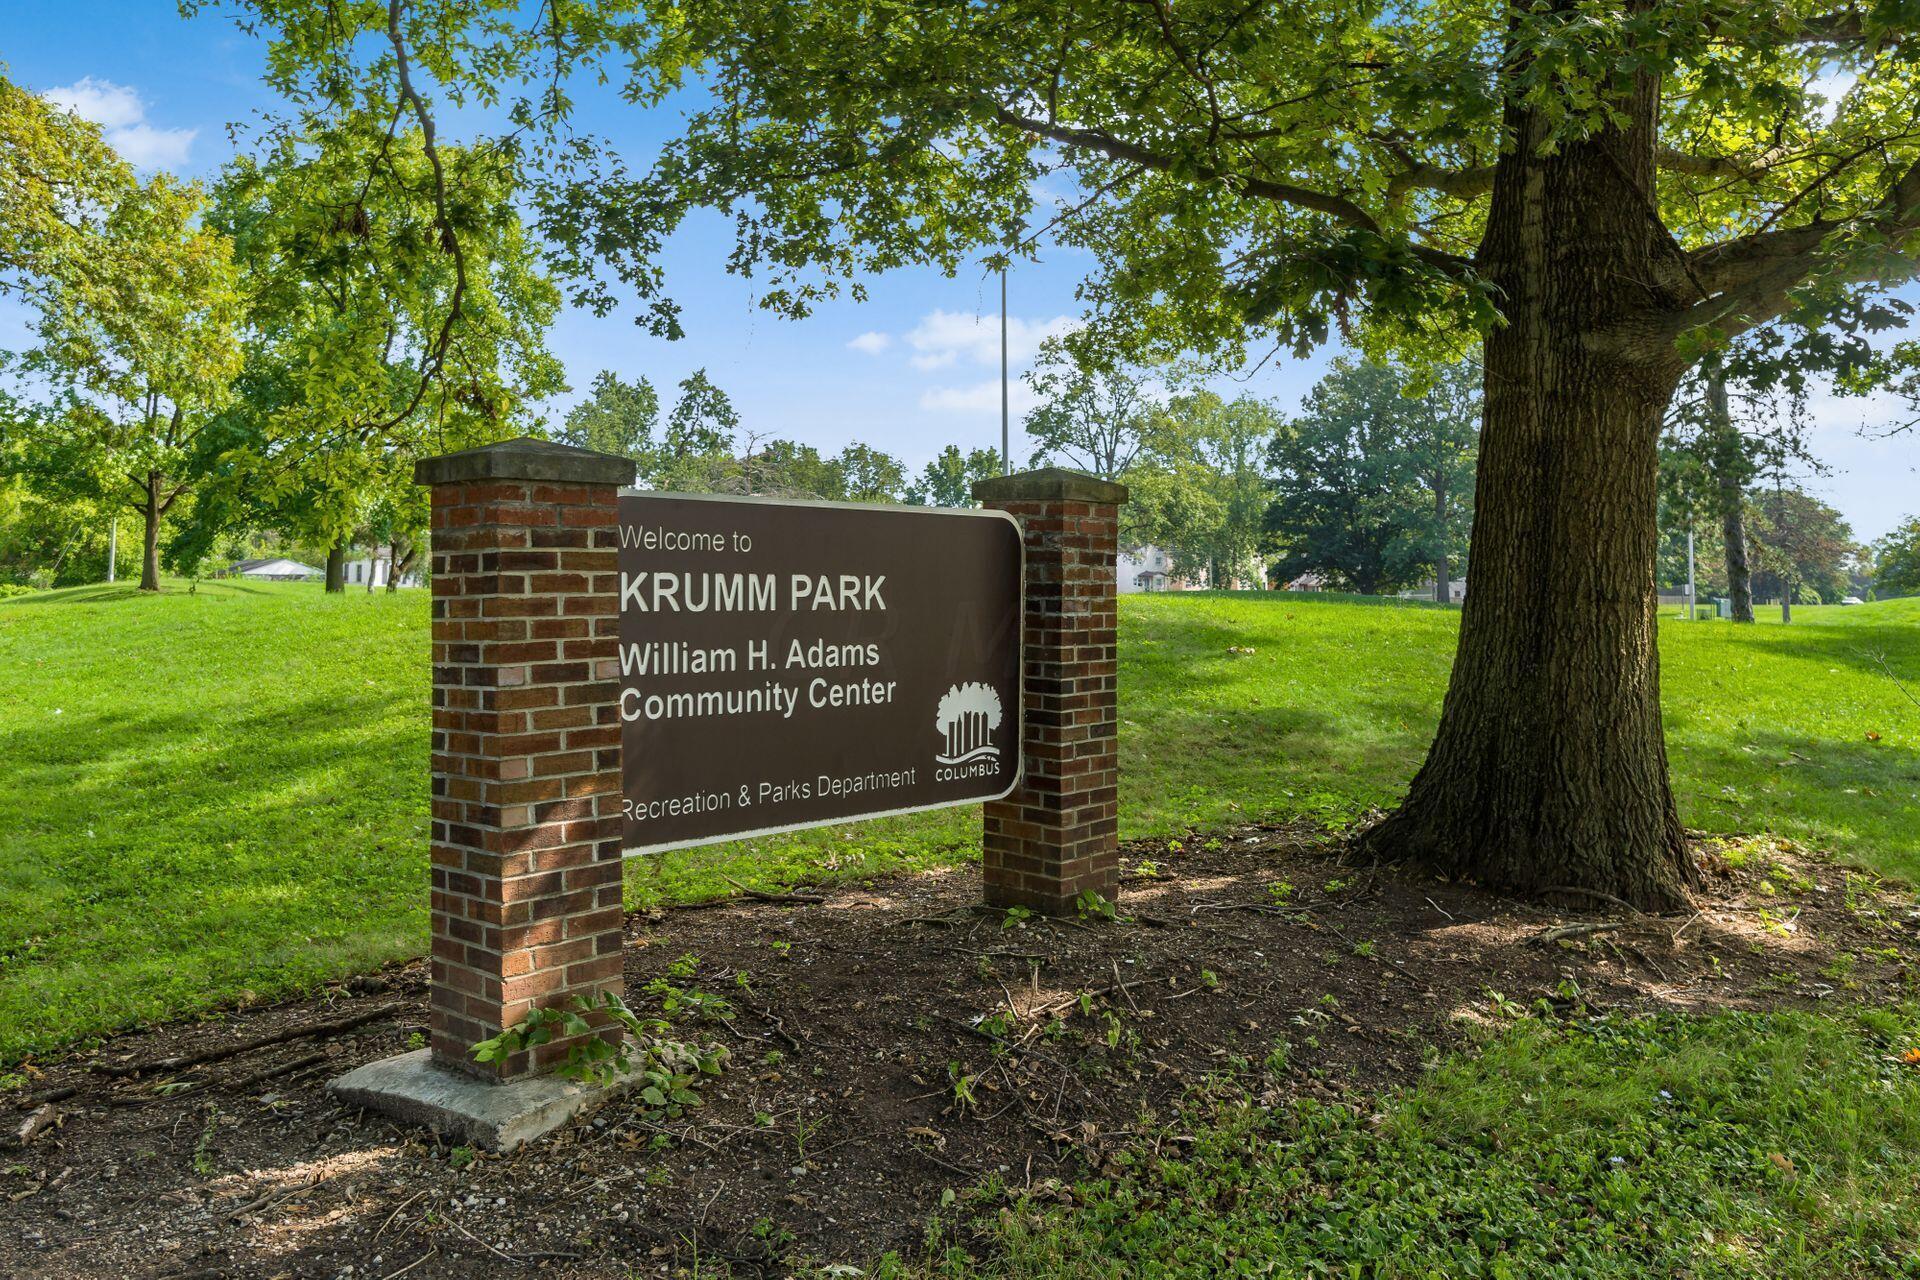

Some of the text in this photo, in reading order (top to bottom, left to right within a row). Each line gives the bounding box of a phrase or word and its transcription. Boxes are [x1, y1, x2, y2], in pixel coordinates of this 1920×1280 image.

[618, 524, 752, 553] Welcome to
[620, 571, 887, 613] KRUMM PARK
[618, 637, 880, 677] William H. Adams
[620, 677, 897, 722] Community Center
[935, 762, 1000, 782] COLUMBUS
[621, 767, 916, 821] Recreation & Parks Department
